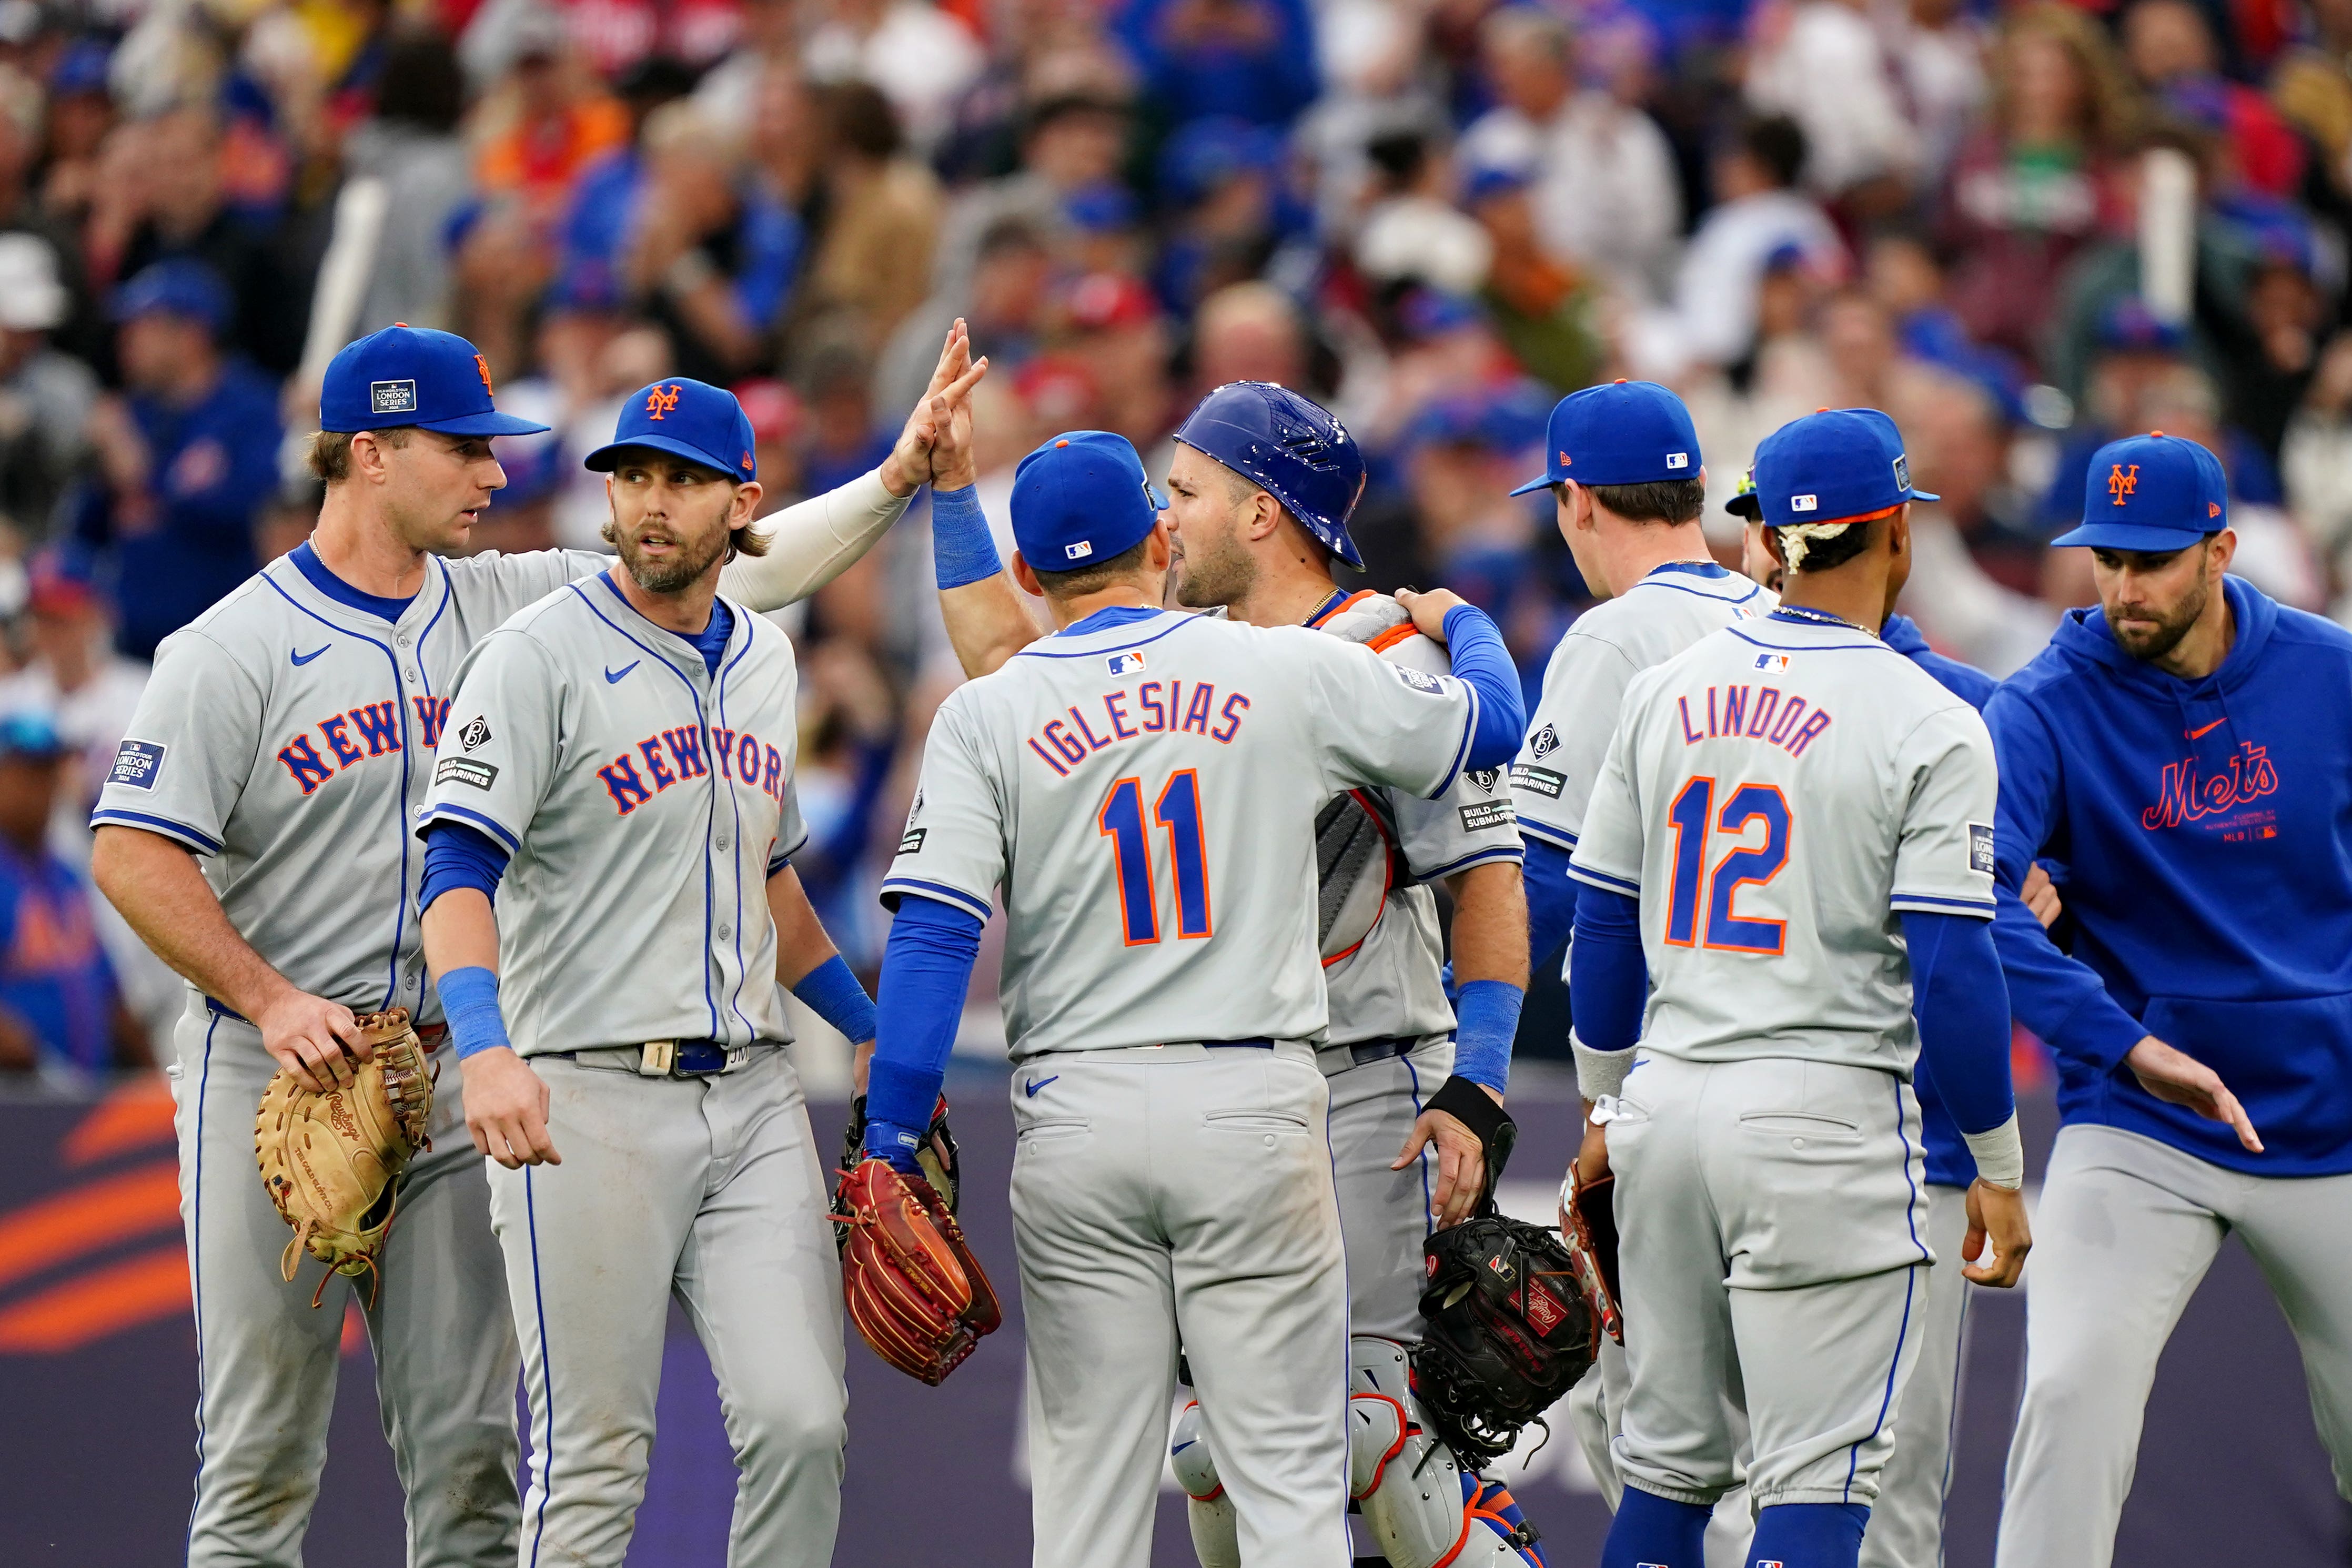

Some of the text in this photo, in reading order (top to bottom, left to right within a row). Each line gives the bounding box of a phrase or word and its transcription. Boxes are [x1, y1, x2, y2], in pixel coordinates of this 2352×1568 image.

[377, 391, 410, 400] LONDON
[1028, 680, 1251, 777] IGLESIAS
[1679, 685, 1831, 758] LINDOR
[116, 755, 154, 770] LONDON
[277, 700, 402, 795] NEW
[115, 765, 145, 778] SERIES
[596, 724, 788, 816] NEW YOR
[2143, 741, 2278, 830] Mets
[1463, 806, 1491, 818] BUILD
[2224, 832, 2245, 843] MLB
[1098, 768, 1213, 946] 11
[1664, 775, 1793, 956] 12
[657, 1046, 663, 1067] 1
[731, 1046, 749, 1064] JM
[326, 1091, 360, 1141] Rawlings
[302, 1160, 315, 1179] GOLD
